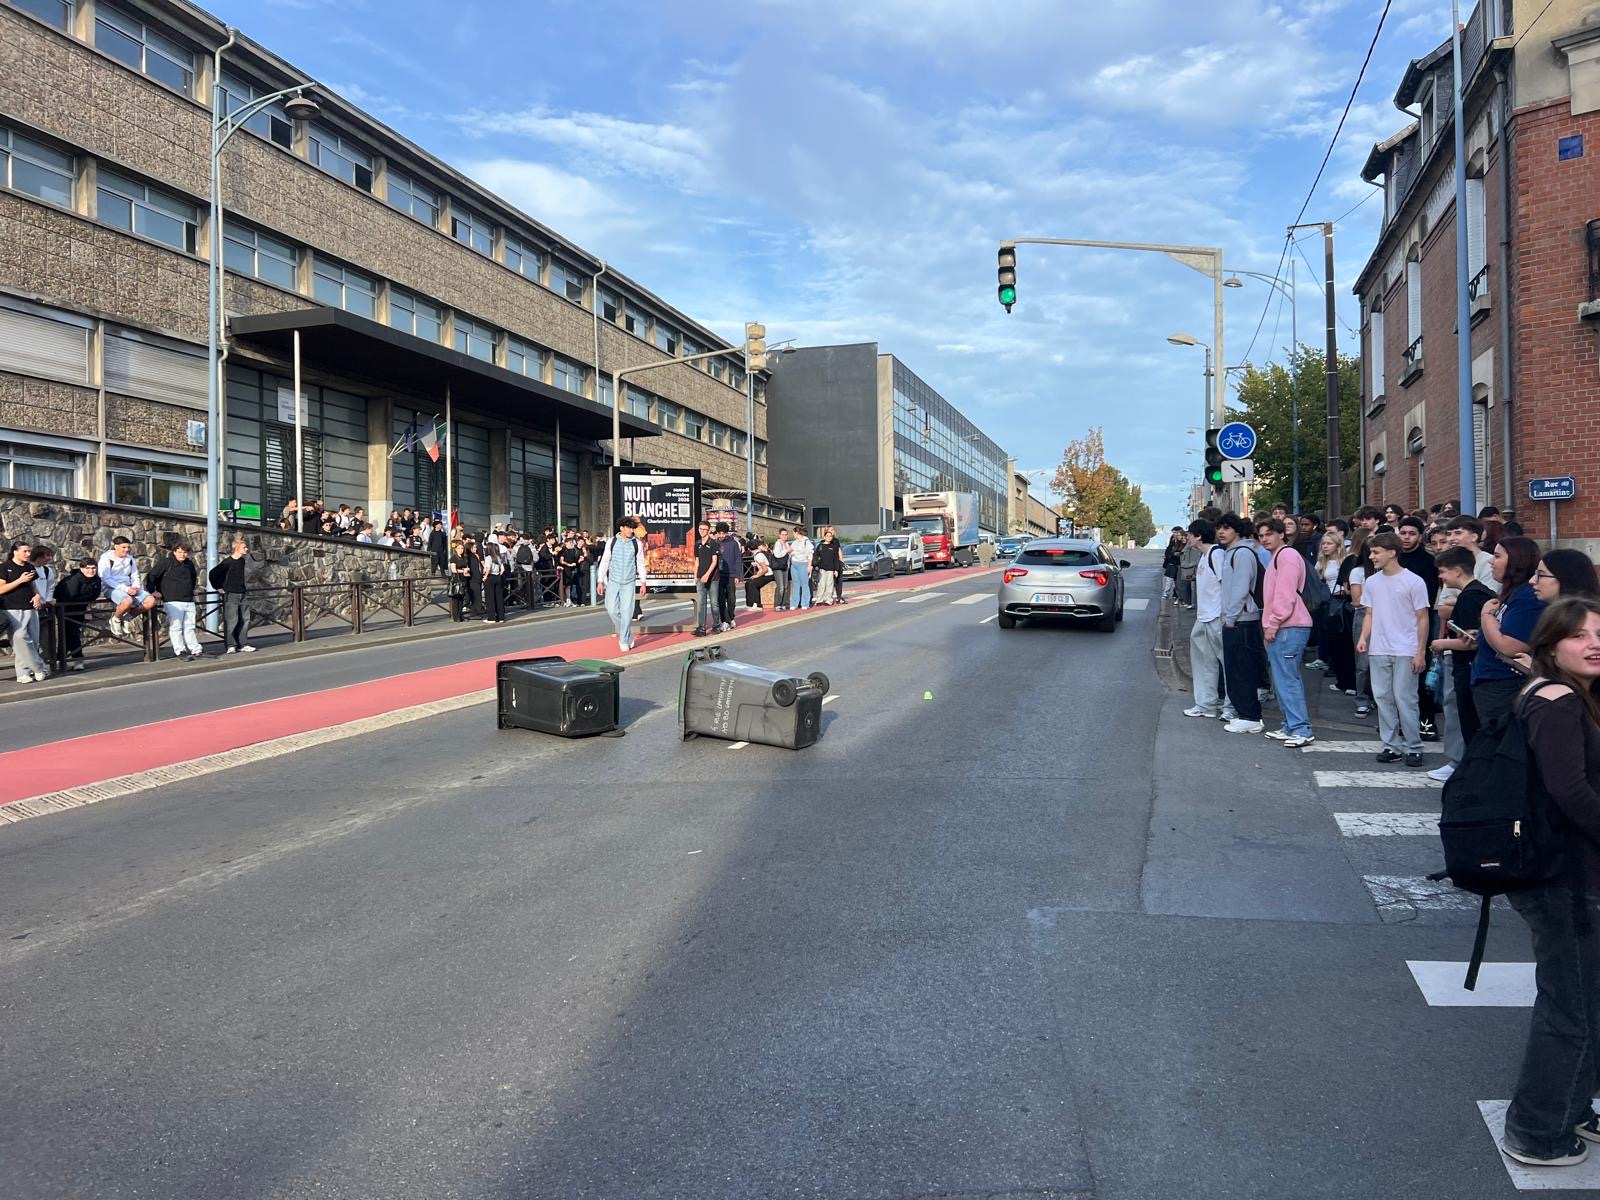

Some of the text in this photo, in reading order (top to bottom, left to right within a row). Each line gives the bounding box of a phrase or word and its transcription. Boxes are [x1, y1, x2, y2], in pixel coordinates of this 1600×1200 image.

[1544, 480, 1559, 488] Rue
[624, 486, 652, 501] NUIT
[1533, 489, 1570, 497] Lamartine
[624, 502, 679, 518] BLANCHE
